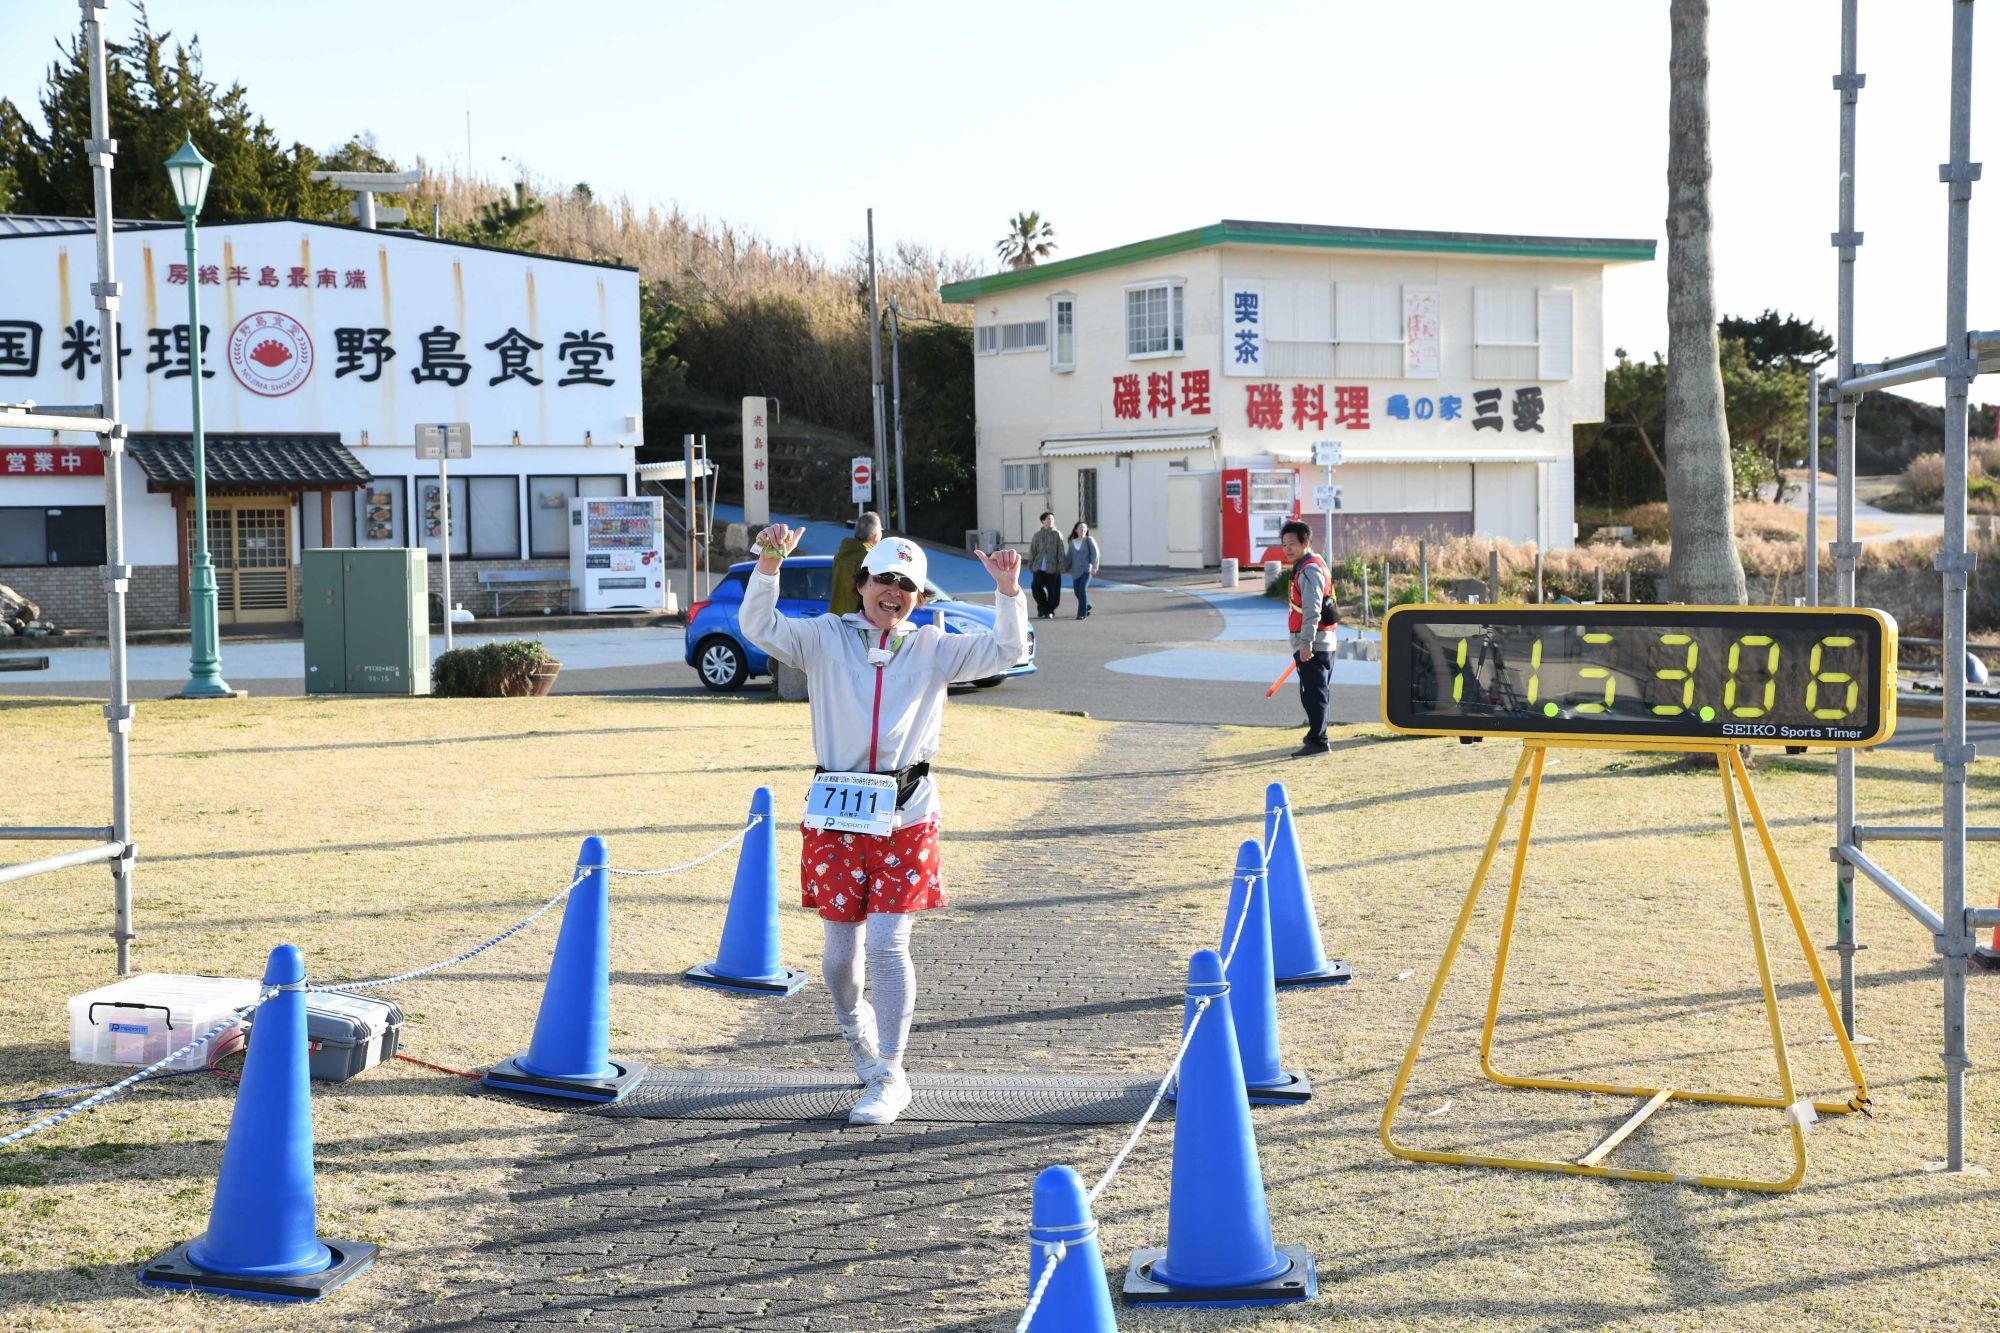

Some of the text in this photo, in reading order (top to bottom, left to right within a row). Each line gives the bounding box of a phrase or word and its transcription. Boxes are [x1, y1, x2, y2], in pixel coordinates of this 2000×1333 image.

[167, 264, 367, 289] 房総半島最南端
[1234, 291, 1259, 364] 喫茶
[334, 325, 616, 387] 野島食堂
[241, 368, 303, 391] NOJIMA SHOKUDO
[1113, 369, 1211, 420] 磯料理
[1246, 383, 1371, 431] 磯料理
[6, 452, 81, 472] 営業中
[1722, 723, 1862, 738] SEIKO Sports Timer
[824, 787, 878, 814] 7111
